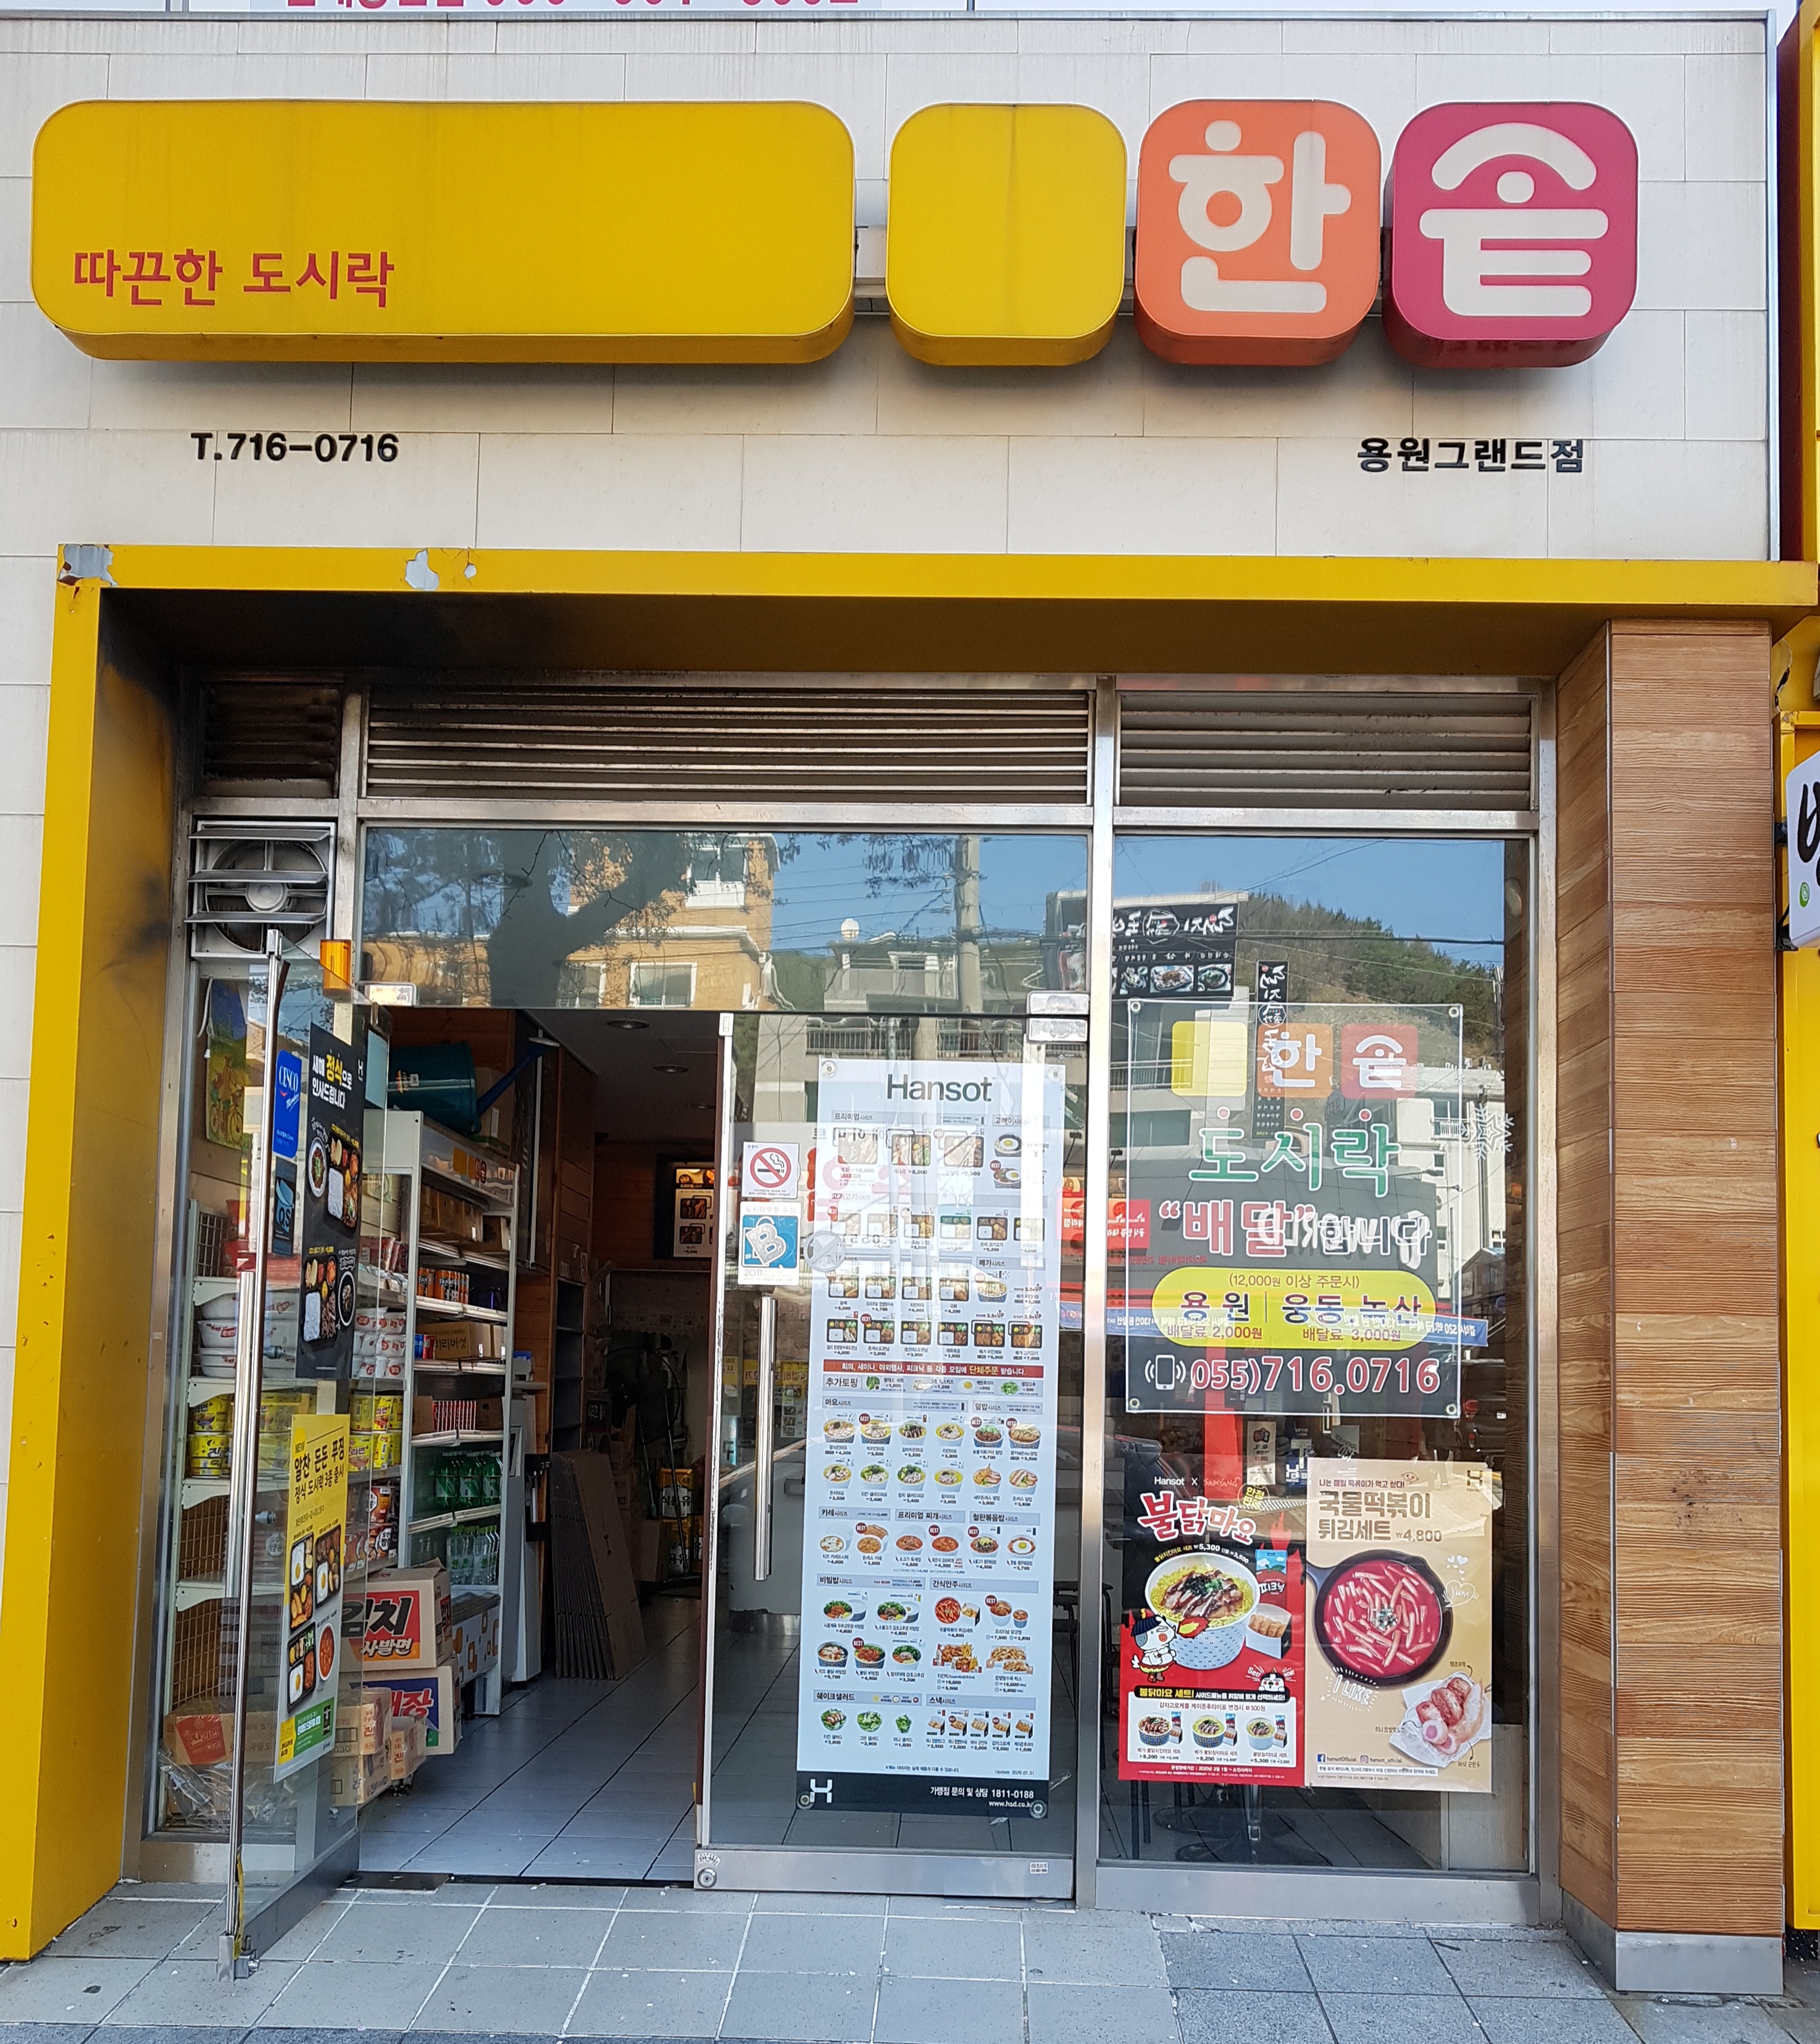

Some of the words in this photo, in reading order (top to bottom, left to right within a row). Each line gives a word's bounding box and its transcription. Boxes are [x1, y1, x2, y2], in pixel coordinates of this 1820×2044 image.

[74, 249, 223, 306] 따끈한
[243, 251, 394, 307] 도시락
[191, 433, 399, 462] T.716-0716
[1358, 438, 1584, 473] 용원그랜드점
[279, 1066, 298, 1092] CESCO
[326, 1054, 353, 1091] 정식으로
[312, 1077, 346, 1109] 인사드립니다
[887, 1074, 991, 1102] Hansot
[1188, 1122, 1402, 1198] 도시락
[744, 1269, 762, 1277] 2011
[1230, 1274, 1280, 1287] (12,000원
[1286, 1275, 1312, 1288] 이상
[1316, 1275, 1359, 1289] 주문시)
[1167, 1327, 1206, 1339] 배달료
[1213, 1327, 1263, 1340] 2,000원
[1303, 1329, 1343, 1341] 배달료
[1351, 1329, 1401, 1343] 3,000원
[969, 1366, 998, 1374] 단체주문
[1191, 1355, 1441, 1395] 055)716.0716
[825, 1378, 858, 1387] 추가토핑
[294, 1453, 311, 1483] 알찬
[314, 1445, 328, 1474] 든든
[294, 1482, 306, 1504] 정식
[308, 1474, 324, 1496] 도시락
[325, 1469, 333, 1488] 3종
[334, 1463, 344, 1484] 출시
[1154, 1477, 1185, 1485] Hansot
[1203, 1477, 1242, 1488] SAMYANG
[1319, 1491, 1430, 1519] 국물떡볶이
[1137, 1490, 1256, 1545] 불닭마요
[1318, 1519, 1391, 1541] 튀김세트
[820, 1576, 853, 1584] 비빔밥시리즈
[1259, 1582, 1285, 1594] 피크닉
[361, 1638, 413, 1658] 사발면
[817, 1692, 855, 1701] 쉐이크샐러드
[1175, 1689, 1195, 1698] 세트!
[1342, 1680, 1373, 1706] LIKE
[930, 1787, 950, 1796] 가맹점
[951, 1787, 964, 1796] 문의
[967, 1788, 973, 1797] 및
[975, 1788, 988, 1797] 상담
[991, 1790, 1033, 1799] 1811-0188
